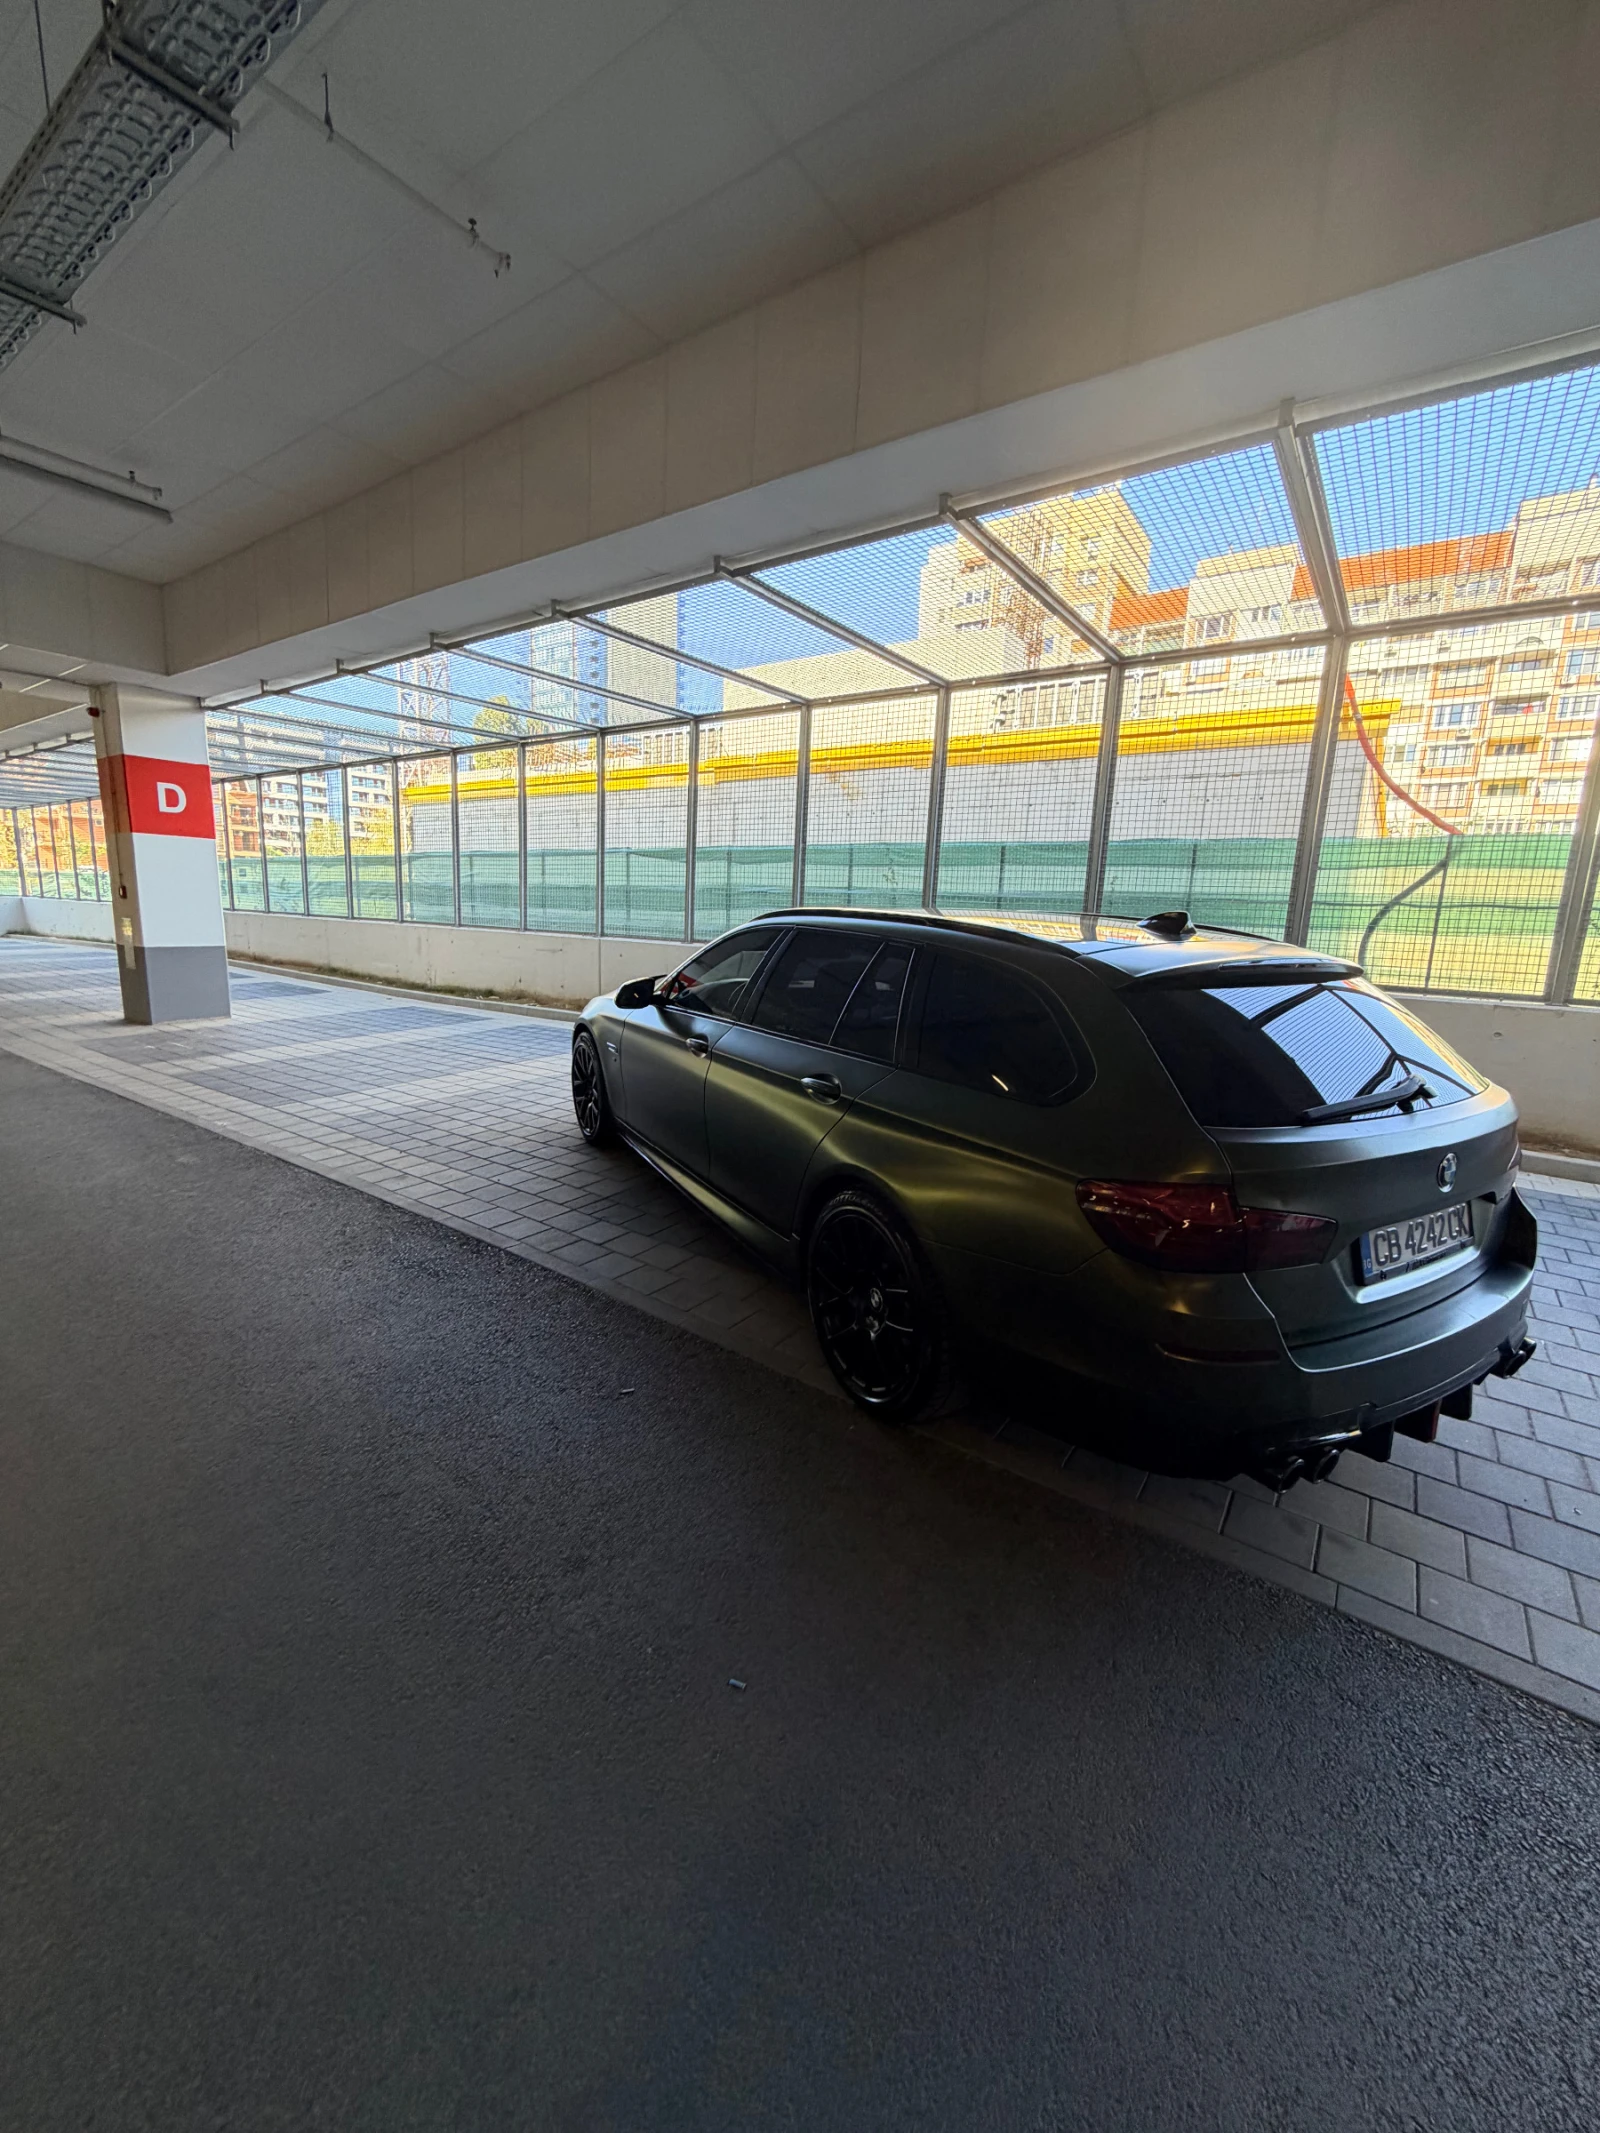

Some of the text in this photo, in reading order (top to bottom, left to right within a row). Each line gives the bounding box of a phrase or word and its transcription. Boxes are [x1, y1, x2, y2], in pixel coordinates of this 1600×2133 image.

[156, 781, 187, 813] D
[1374, 1227, 1402, 1266] CB
[1405, 1212, 1448, 1256] 4242
[1448, 1203, 1469, 1240] CK
